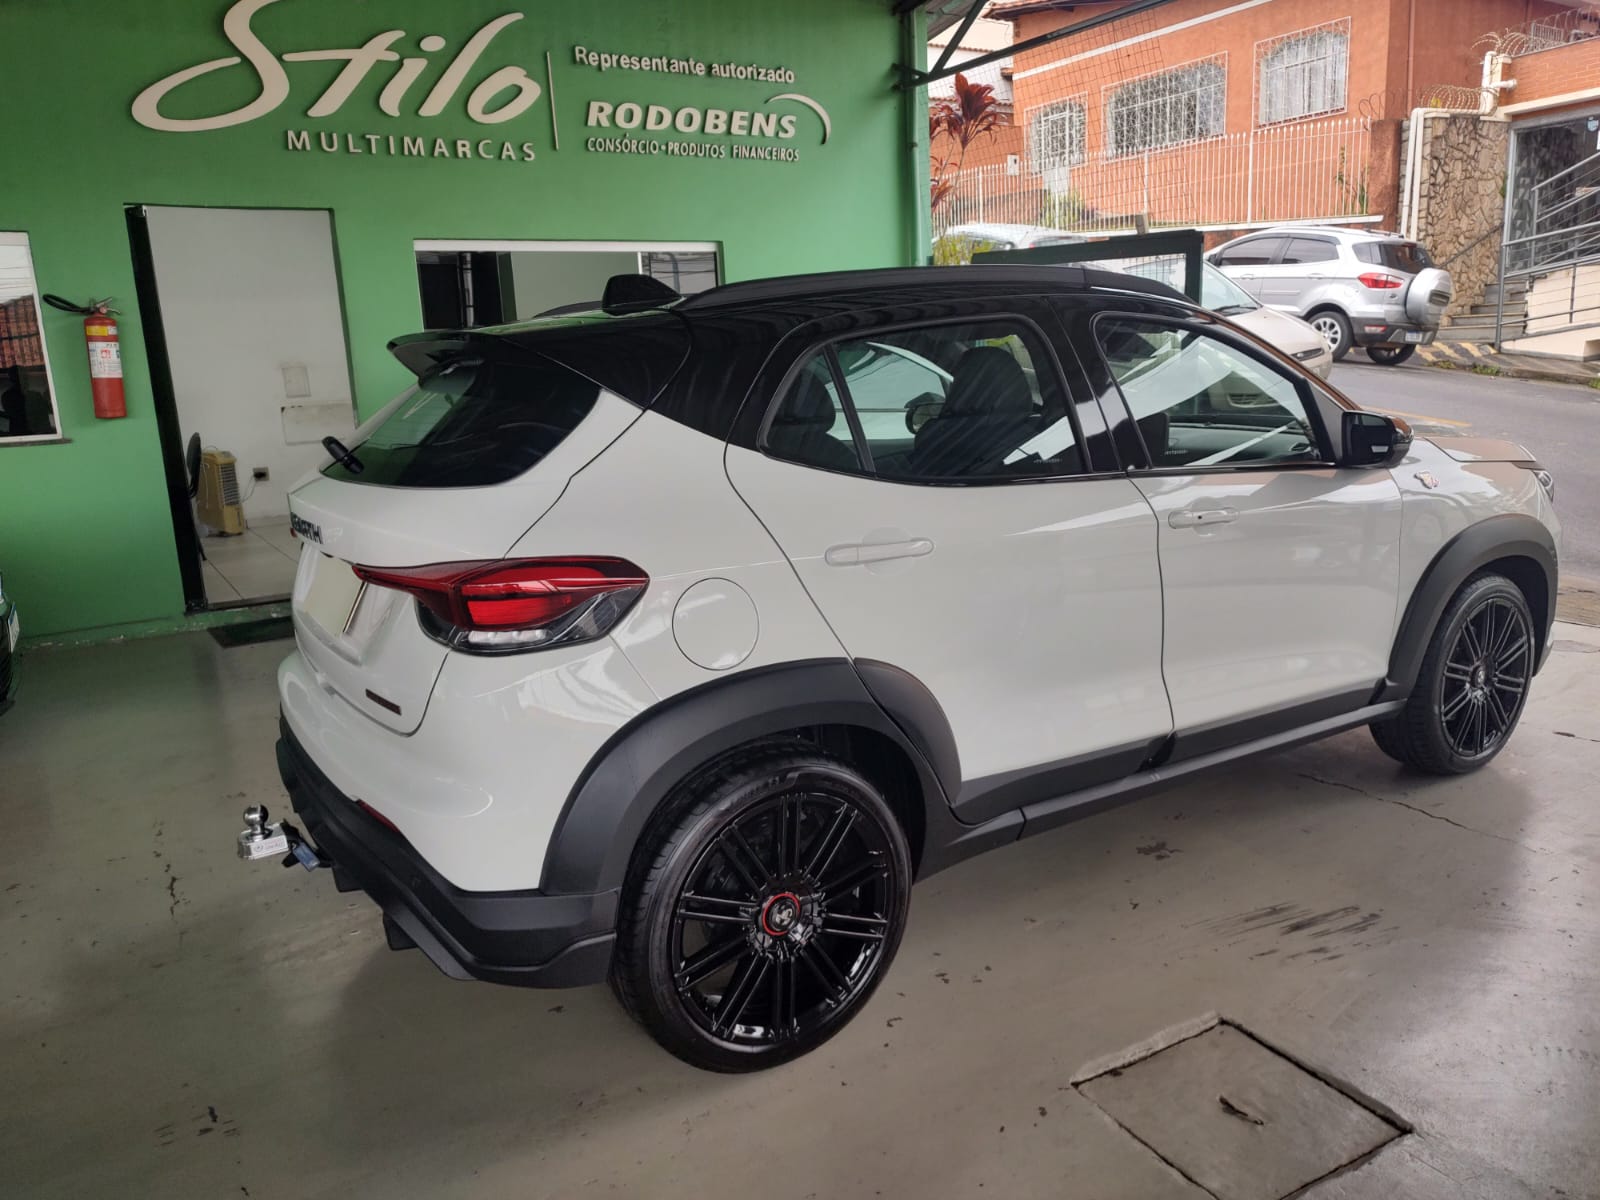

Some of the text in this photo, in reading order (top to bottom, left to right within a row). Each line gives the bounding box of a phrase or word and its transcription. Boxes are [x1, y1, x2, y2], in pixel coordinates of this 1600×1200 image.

[131, 0, 541, 133] Stilo
[574, 46, 796, 83] Representante autorizado
[586, 101, 798, 139] RODOBENS
[286, 130, 536, 161] MULTIMARCAS
[732, 144, 800, 162] FINANCEIROS
